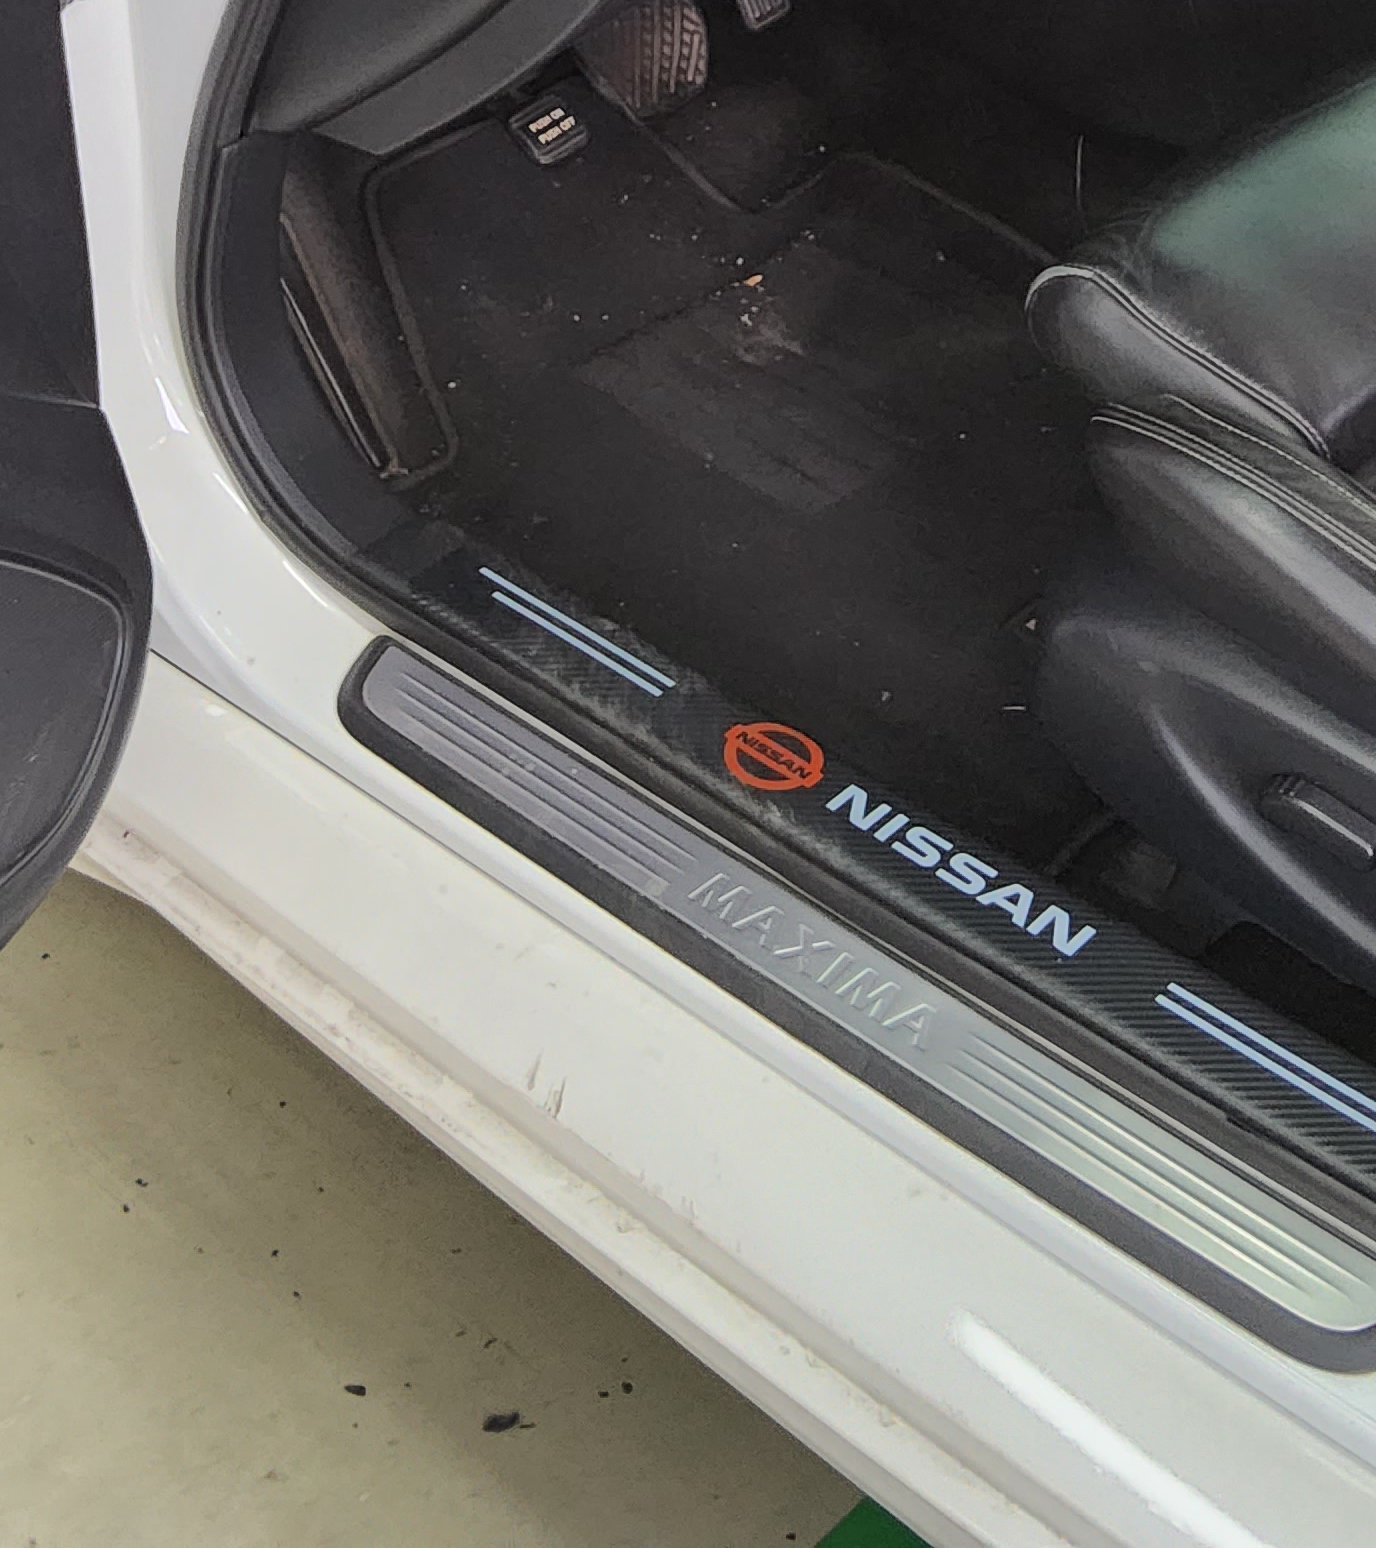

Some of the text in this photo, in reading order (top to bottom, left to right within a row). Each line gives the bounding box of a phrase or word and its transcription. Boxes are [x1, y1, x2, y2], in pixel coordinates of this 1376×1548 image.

[736, 731, 813, 779] NISSAN
[825, 784, 1097, 958] NISSAN
[687, 872, 938, 1046] MAXIMA
